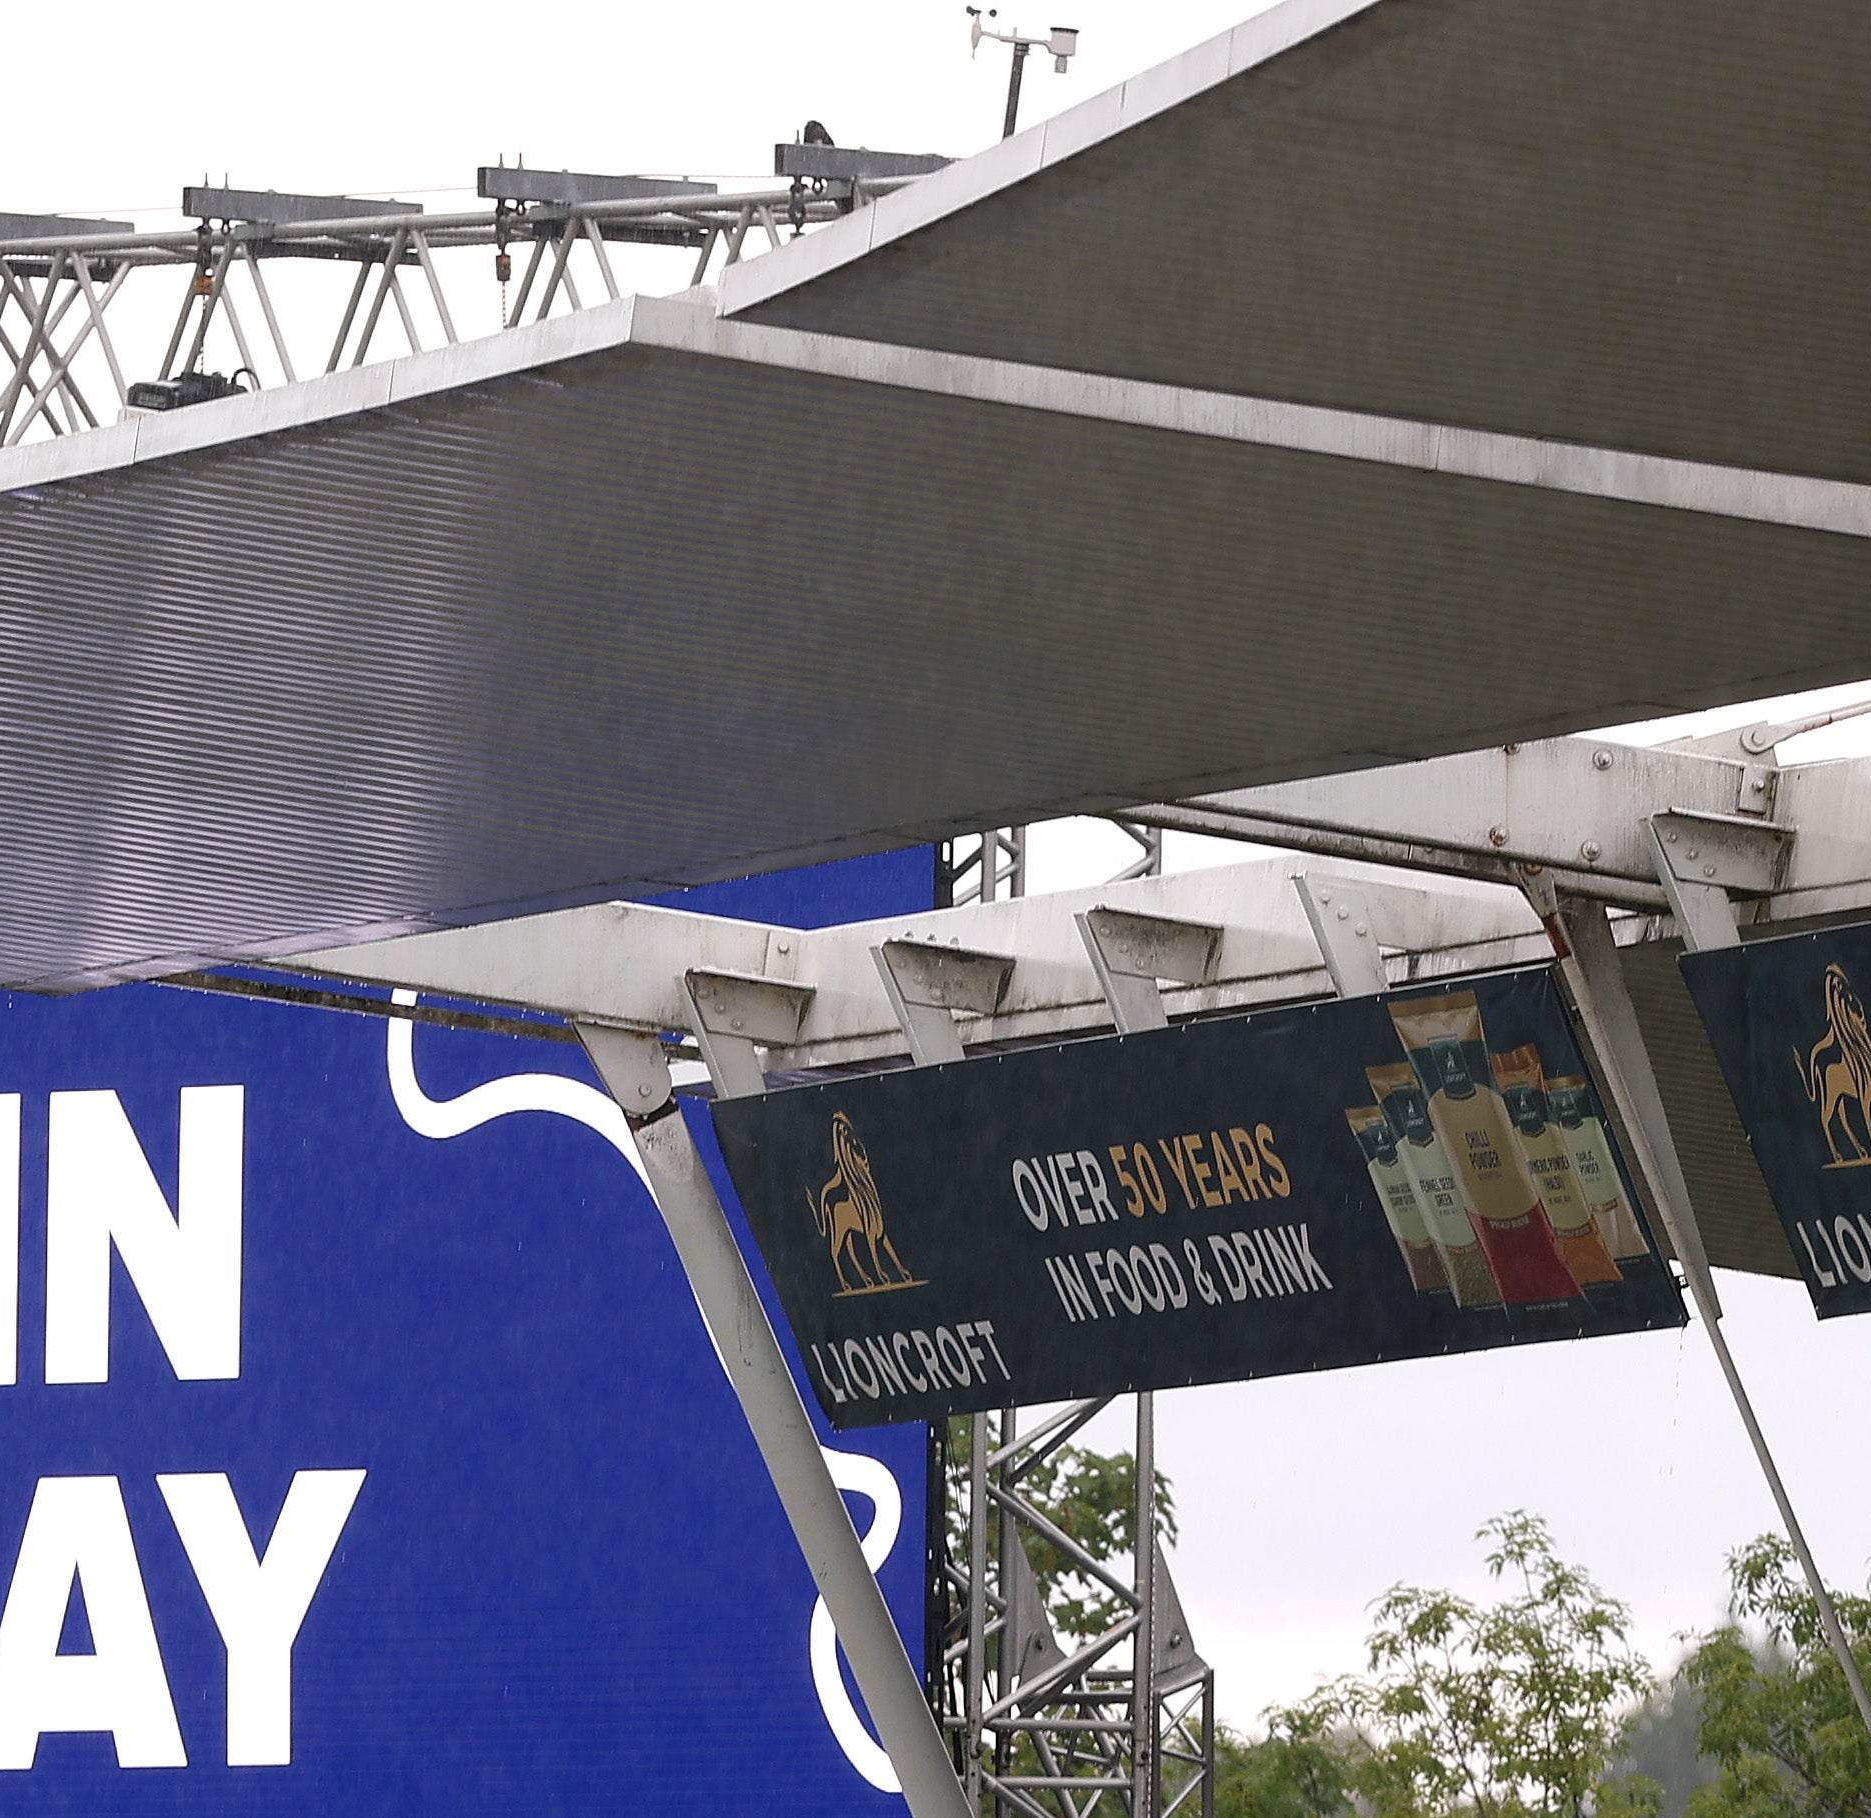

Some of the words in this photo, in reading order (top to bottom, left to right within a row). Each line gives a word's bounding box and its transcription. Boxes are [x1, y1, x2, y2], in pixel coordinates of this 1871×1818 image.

[1012, 1150, 1120, 1233] OVER
[1108, 1142, 1167, 1217] 50
[1159, 1123, 1292, 1211] YEARS
[1464, 1129, 1490, 1149] CHILLI
[1468, 1150, 1502, 1171] POWDER
[1044, 1254, 1099, 1323] IN
[1087, 1243, 1189, 1317] FOOD
[1184, 1238, 1220, 1302] &
[1207, 1223, 1335, 1302] DRINK
[810, 1320, 1012, 1403] LIONCROFT
